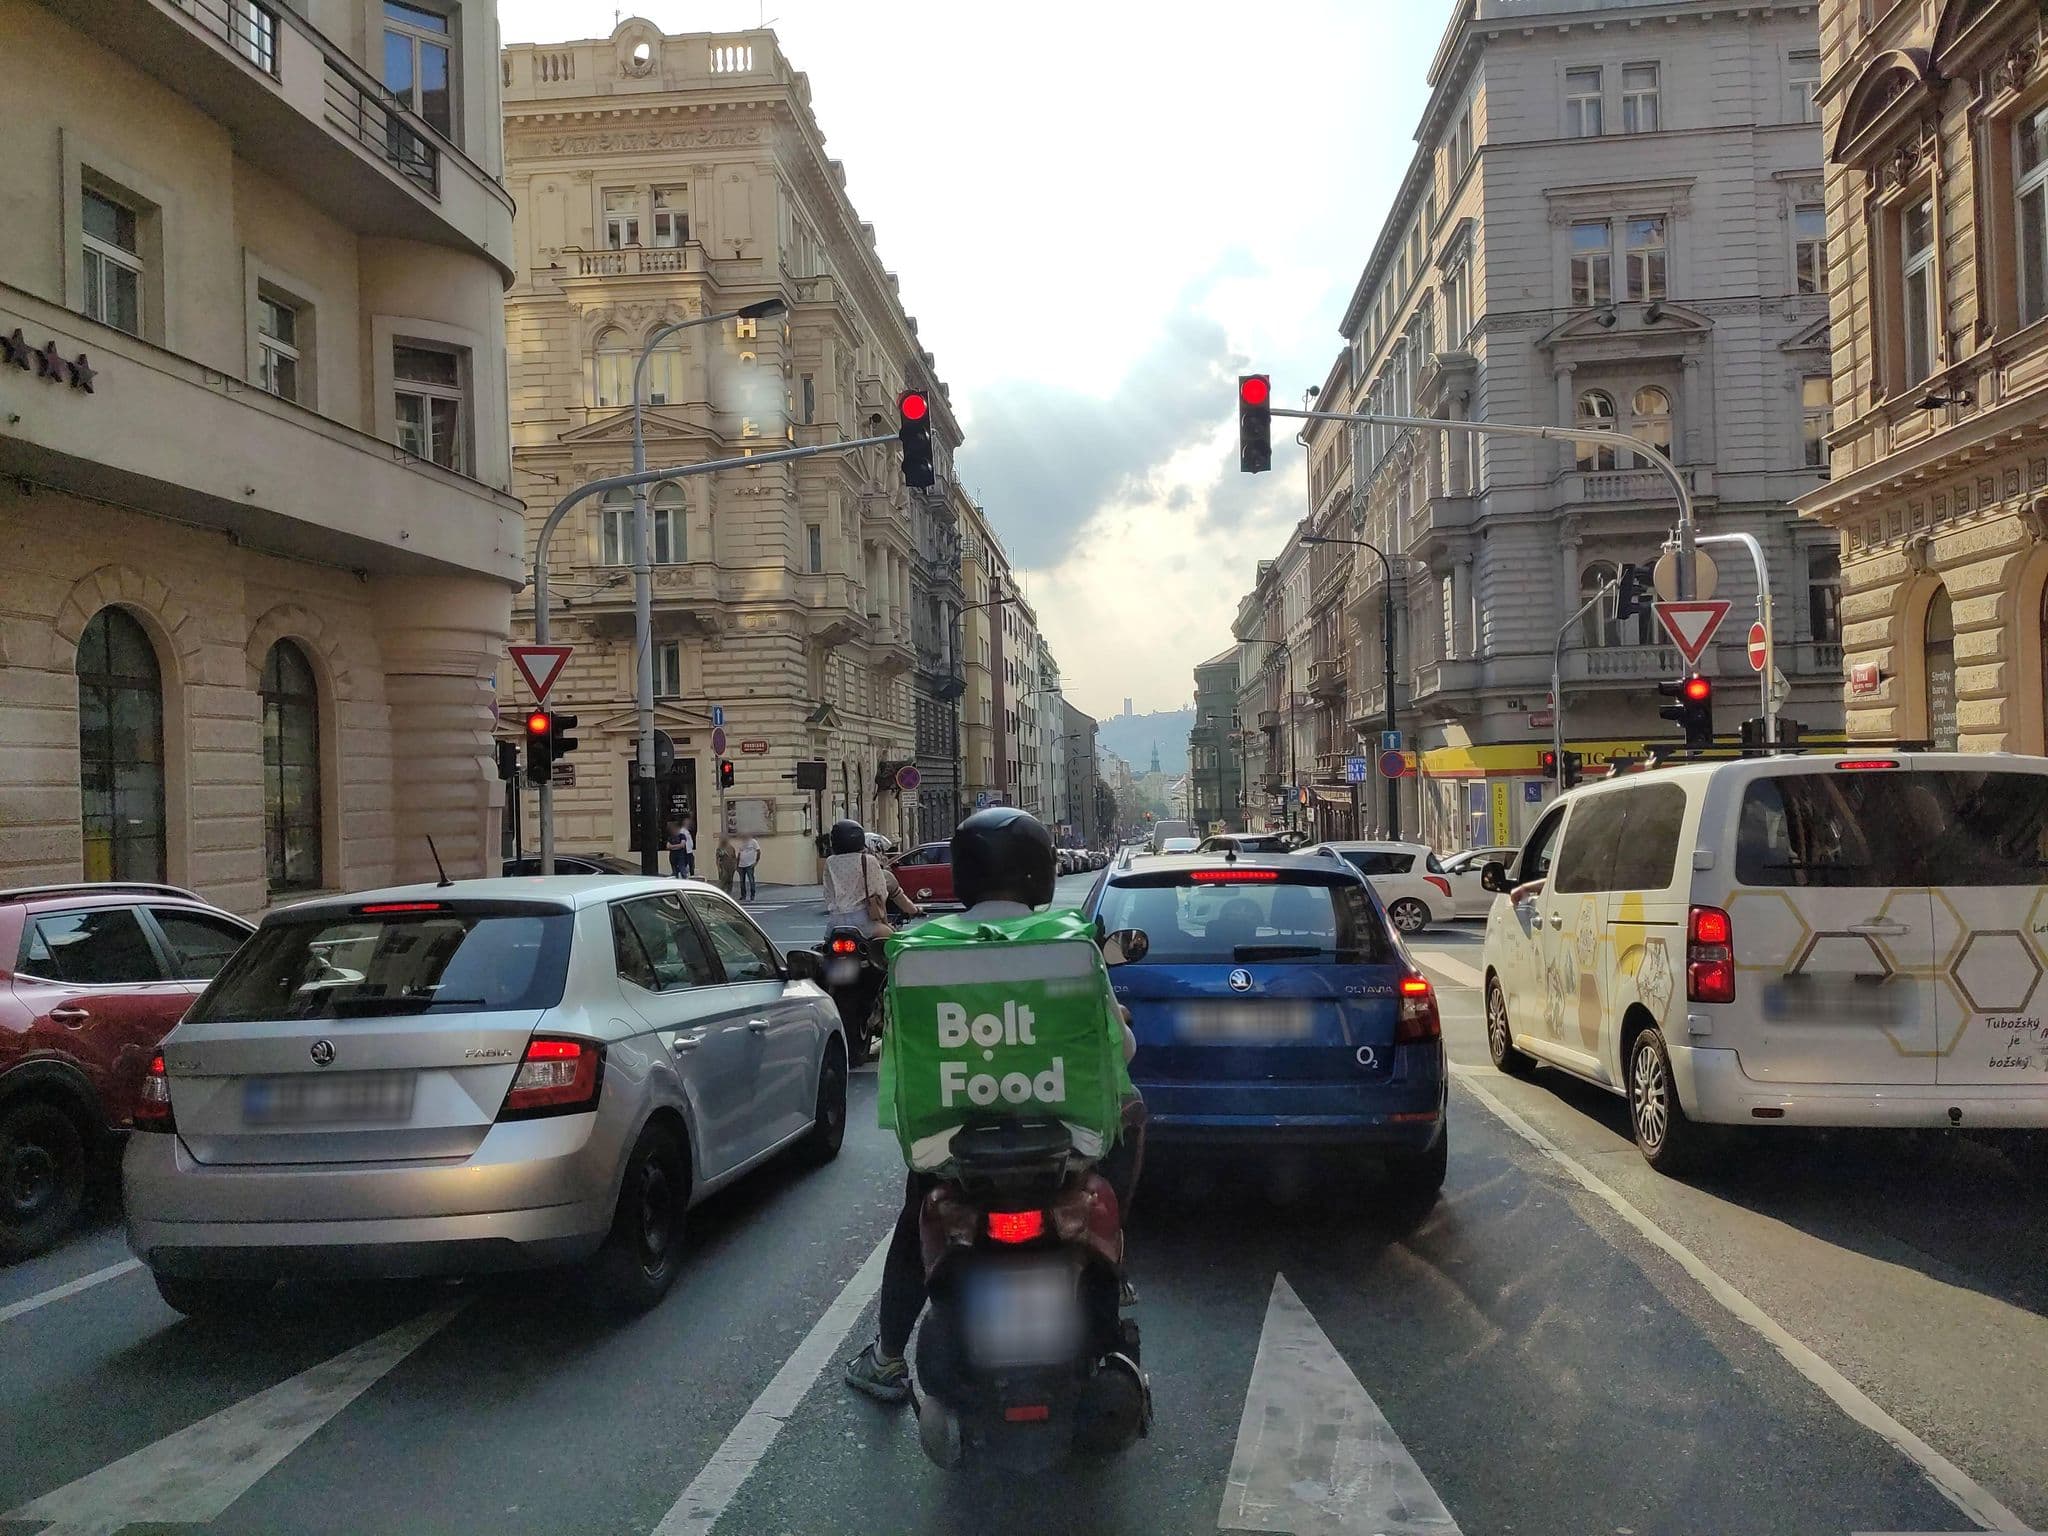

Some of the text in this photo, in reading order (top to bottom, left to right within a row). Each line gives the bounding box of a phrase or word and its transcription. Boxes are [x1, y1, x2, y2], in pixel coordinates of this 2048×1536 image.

[736, 317, 761, 469] HOTEL
[1345, 985, 1393, 994] OCTAVIA
[937, 1000, 1036, 1048] Bolt
[1985, 1016, 2040, 1031] Tubožský
[2008, 1034, 2021, 1049] je
[464, 1049, 513, 1058] FABIA
[1989, 1056, 2030, 1070] božský
[940, 1056, 1066, 1107] Food
